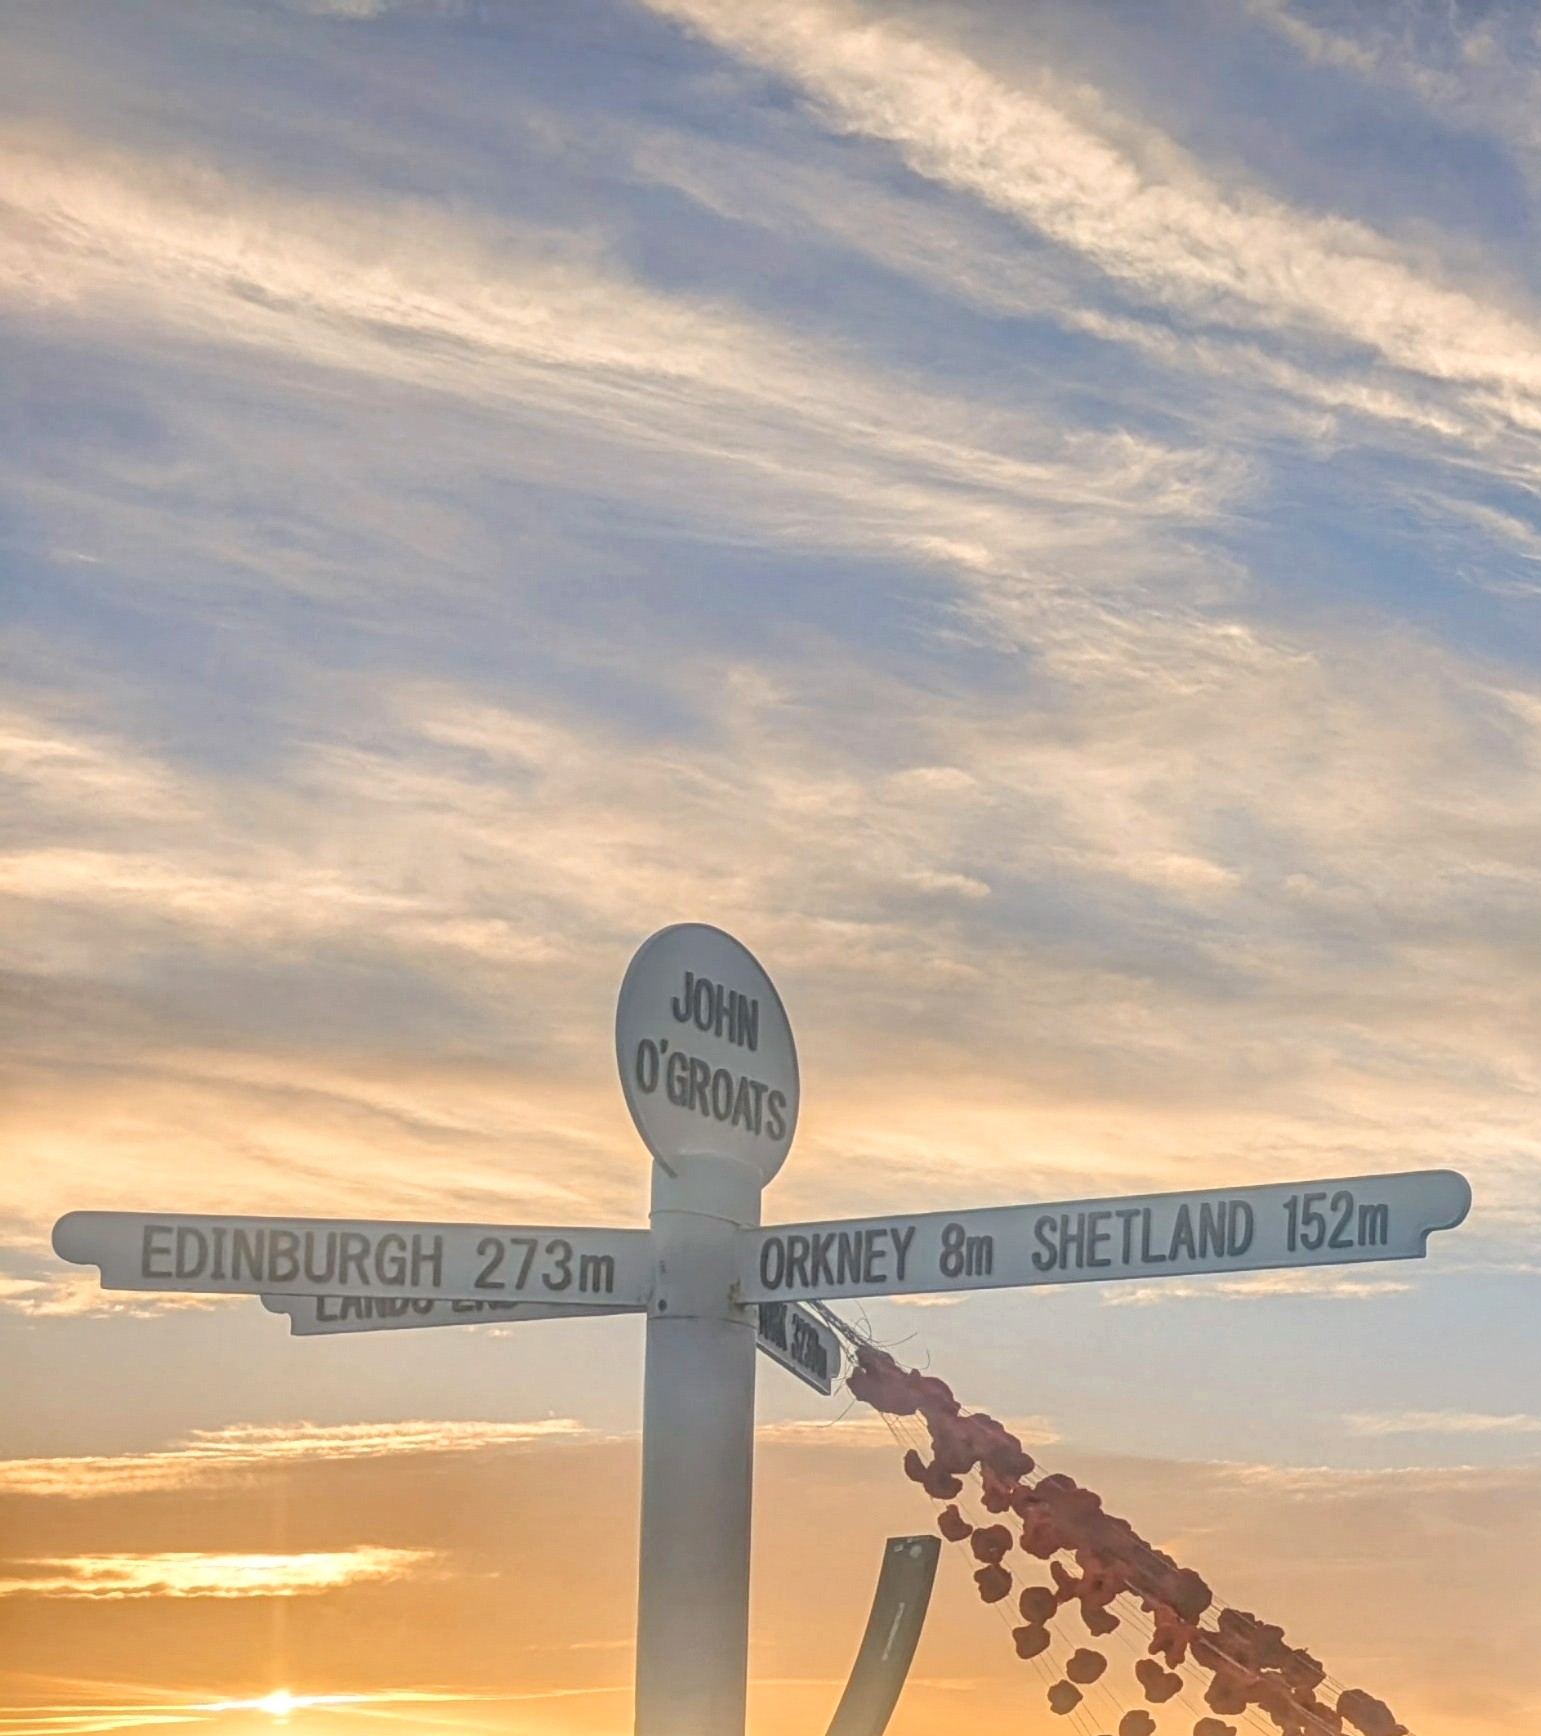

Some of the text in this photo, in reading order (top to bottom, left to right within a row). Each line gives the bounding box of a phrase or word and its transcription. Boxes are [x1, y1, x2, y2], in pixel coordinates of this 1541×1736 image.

[672, 971, 759, 1052] JOHN
[636, 1038, 787, 1141] O'GROATS
[141, 1225, 615, 1294] EDINBURGH 273m
[760, 1190, 1389, 1290] ORKNEY 8m SHETLAND 152m
